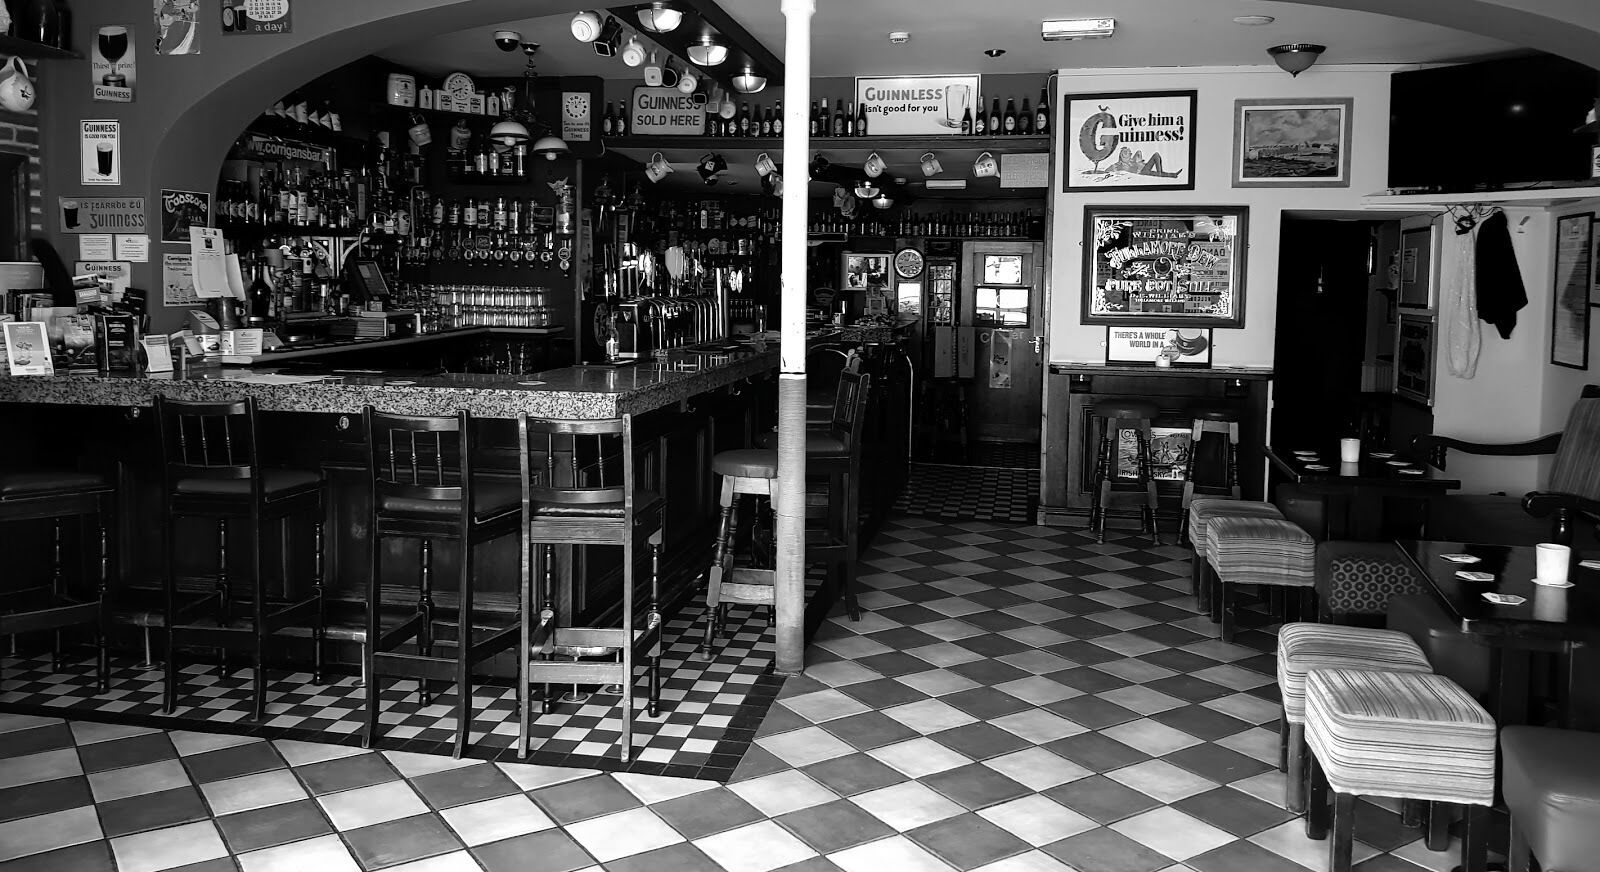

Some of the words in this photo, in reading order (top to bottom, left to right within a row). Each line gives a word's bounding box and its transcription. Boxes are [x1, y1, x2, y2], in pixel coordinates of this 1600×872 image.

[255, 24, 262, 32] a
[264, 22, 287, 33] day!
[95, 87, 130, 99] GUINNESS
[865, 86, 943, 102] GUINNLESS
[865, 103, 882, 113] isn't
[883, 103, 906, 116] good
[907, 103, 920, 113] for
[922, 104, 939, 114] you
[637, 115, 667, 126] SOLD
[670, 115, 701, 126] HERE
[1118, 113, 1147, 127] Give
[1148, 112, 1176, 126] him
[1176, 116, 1184, 126] a
[84, 123, 116, 133] GUINNESS
[90, 213, 144, 229] GUINNESS
[1186, 244, 1220, 270] DEW
[84, 263, 121, 272] GUINNESS
[1114, 331, 1138, 339] THERE'S
[1139, 331, 1144, 339] A
[1144, 332, 1166, 340] WHOLE
[1129, 340, 1151, 348] WORLD
[1159, 341, 1165, 349] A
